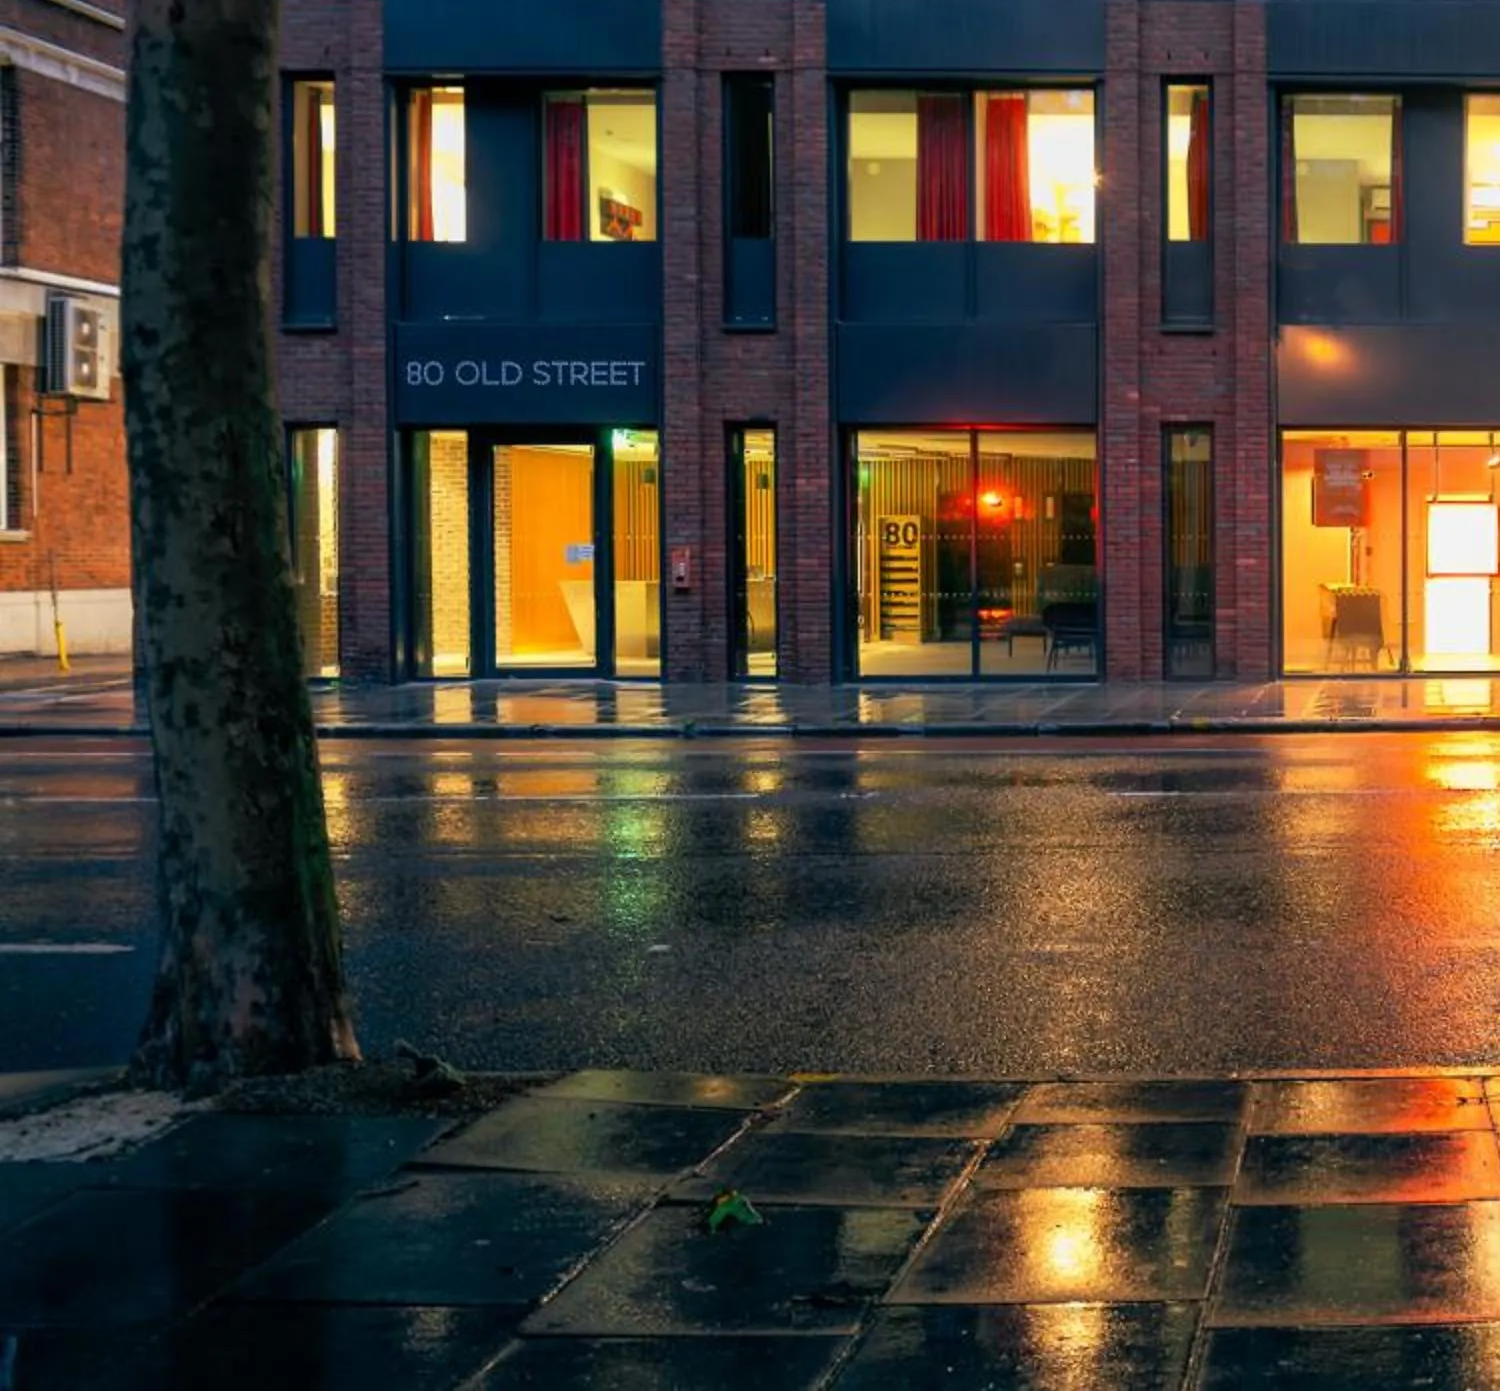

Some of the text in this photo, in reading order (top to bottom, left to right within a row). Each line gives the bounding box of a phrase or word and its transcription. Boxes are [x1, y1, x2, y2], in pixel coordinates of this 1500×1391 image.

[406, 360, 646, 386] 80 OLD STREET
[885, 522, 918, 546] 80
